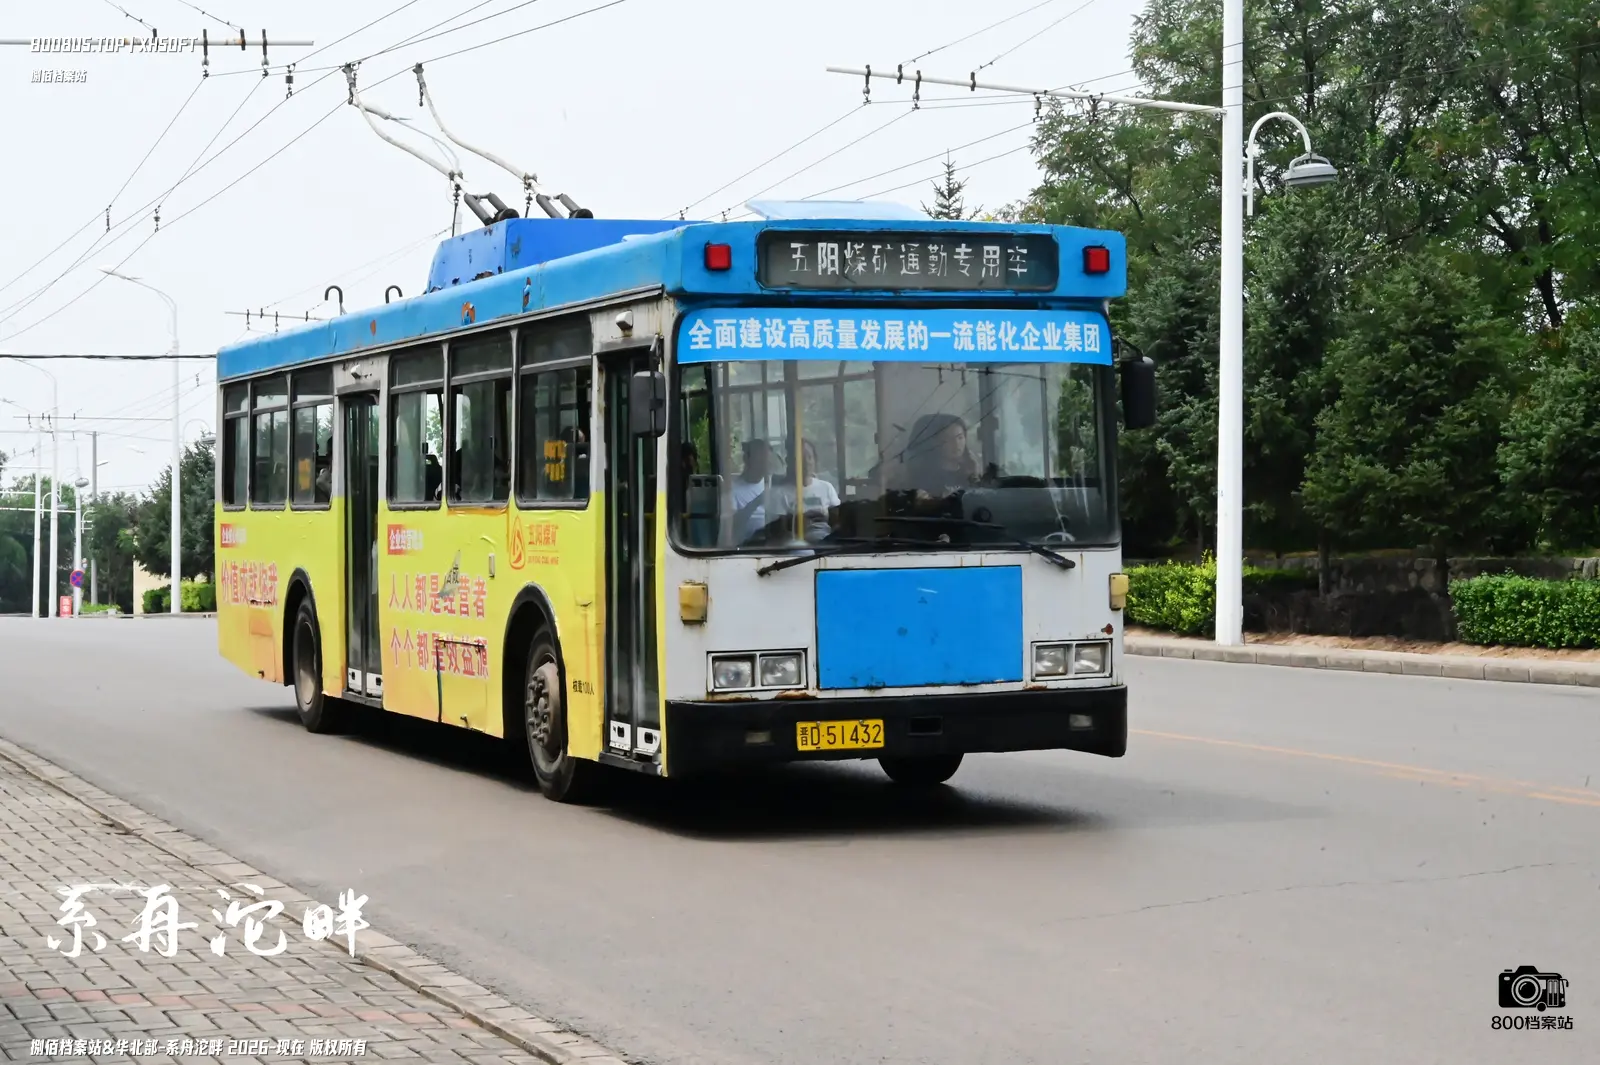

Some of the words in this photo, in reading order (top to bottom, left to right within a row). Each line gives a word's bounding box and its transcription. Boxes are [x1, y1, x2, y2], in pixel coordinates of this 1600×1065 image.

[790, 241, 1028, 278] 五阳煤矿通勤专用车
[688, 317, 1101, 353] 全面建设高质量发展的一流能化企业集团
